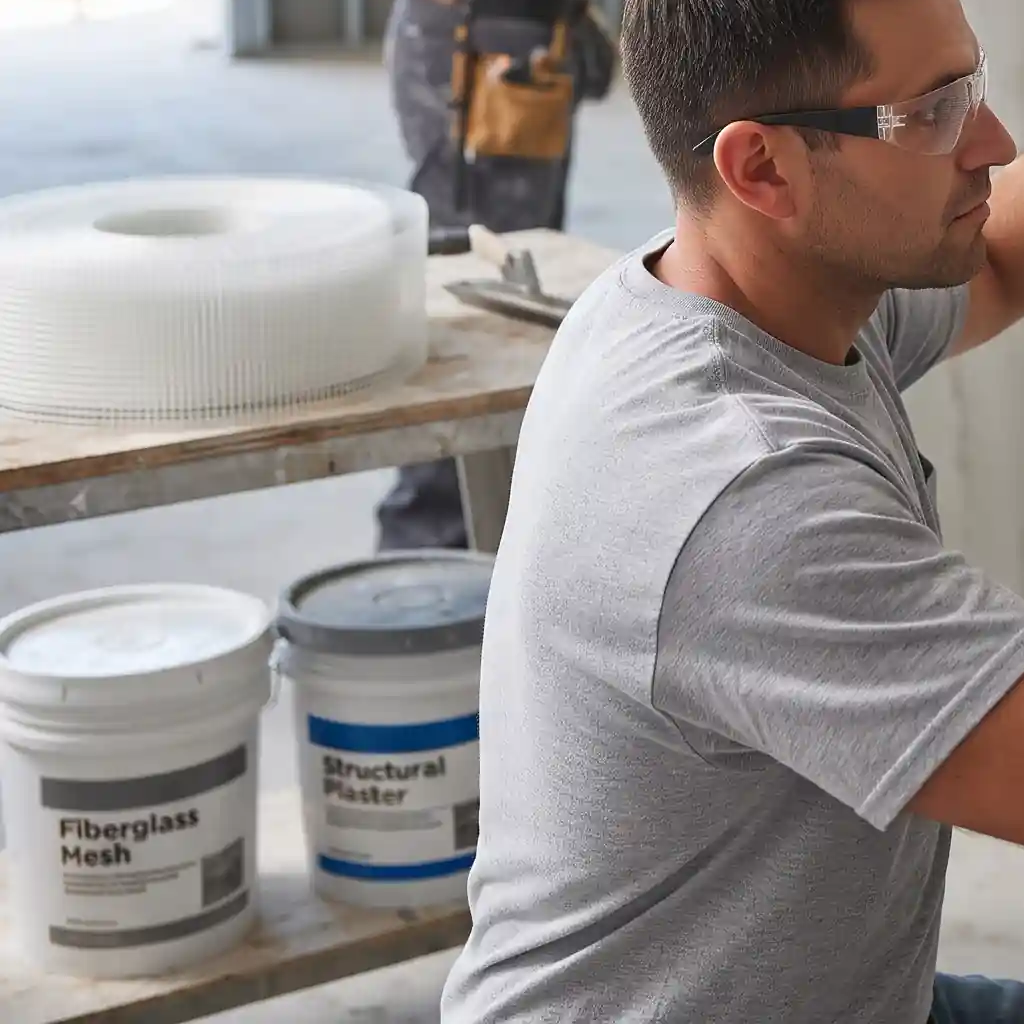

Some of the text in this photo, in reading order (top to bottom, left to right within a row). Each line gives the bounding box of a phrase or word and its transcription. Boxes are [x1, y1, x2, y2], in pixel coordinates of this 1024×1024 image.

[323, 755, 446, 781] Structural
[323, 777, 408, 806] Plaster
[59, 808, 199, 842] Fiberglass
[60, 842, 132, 867] Mesh
